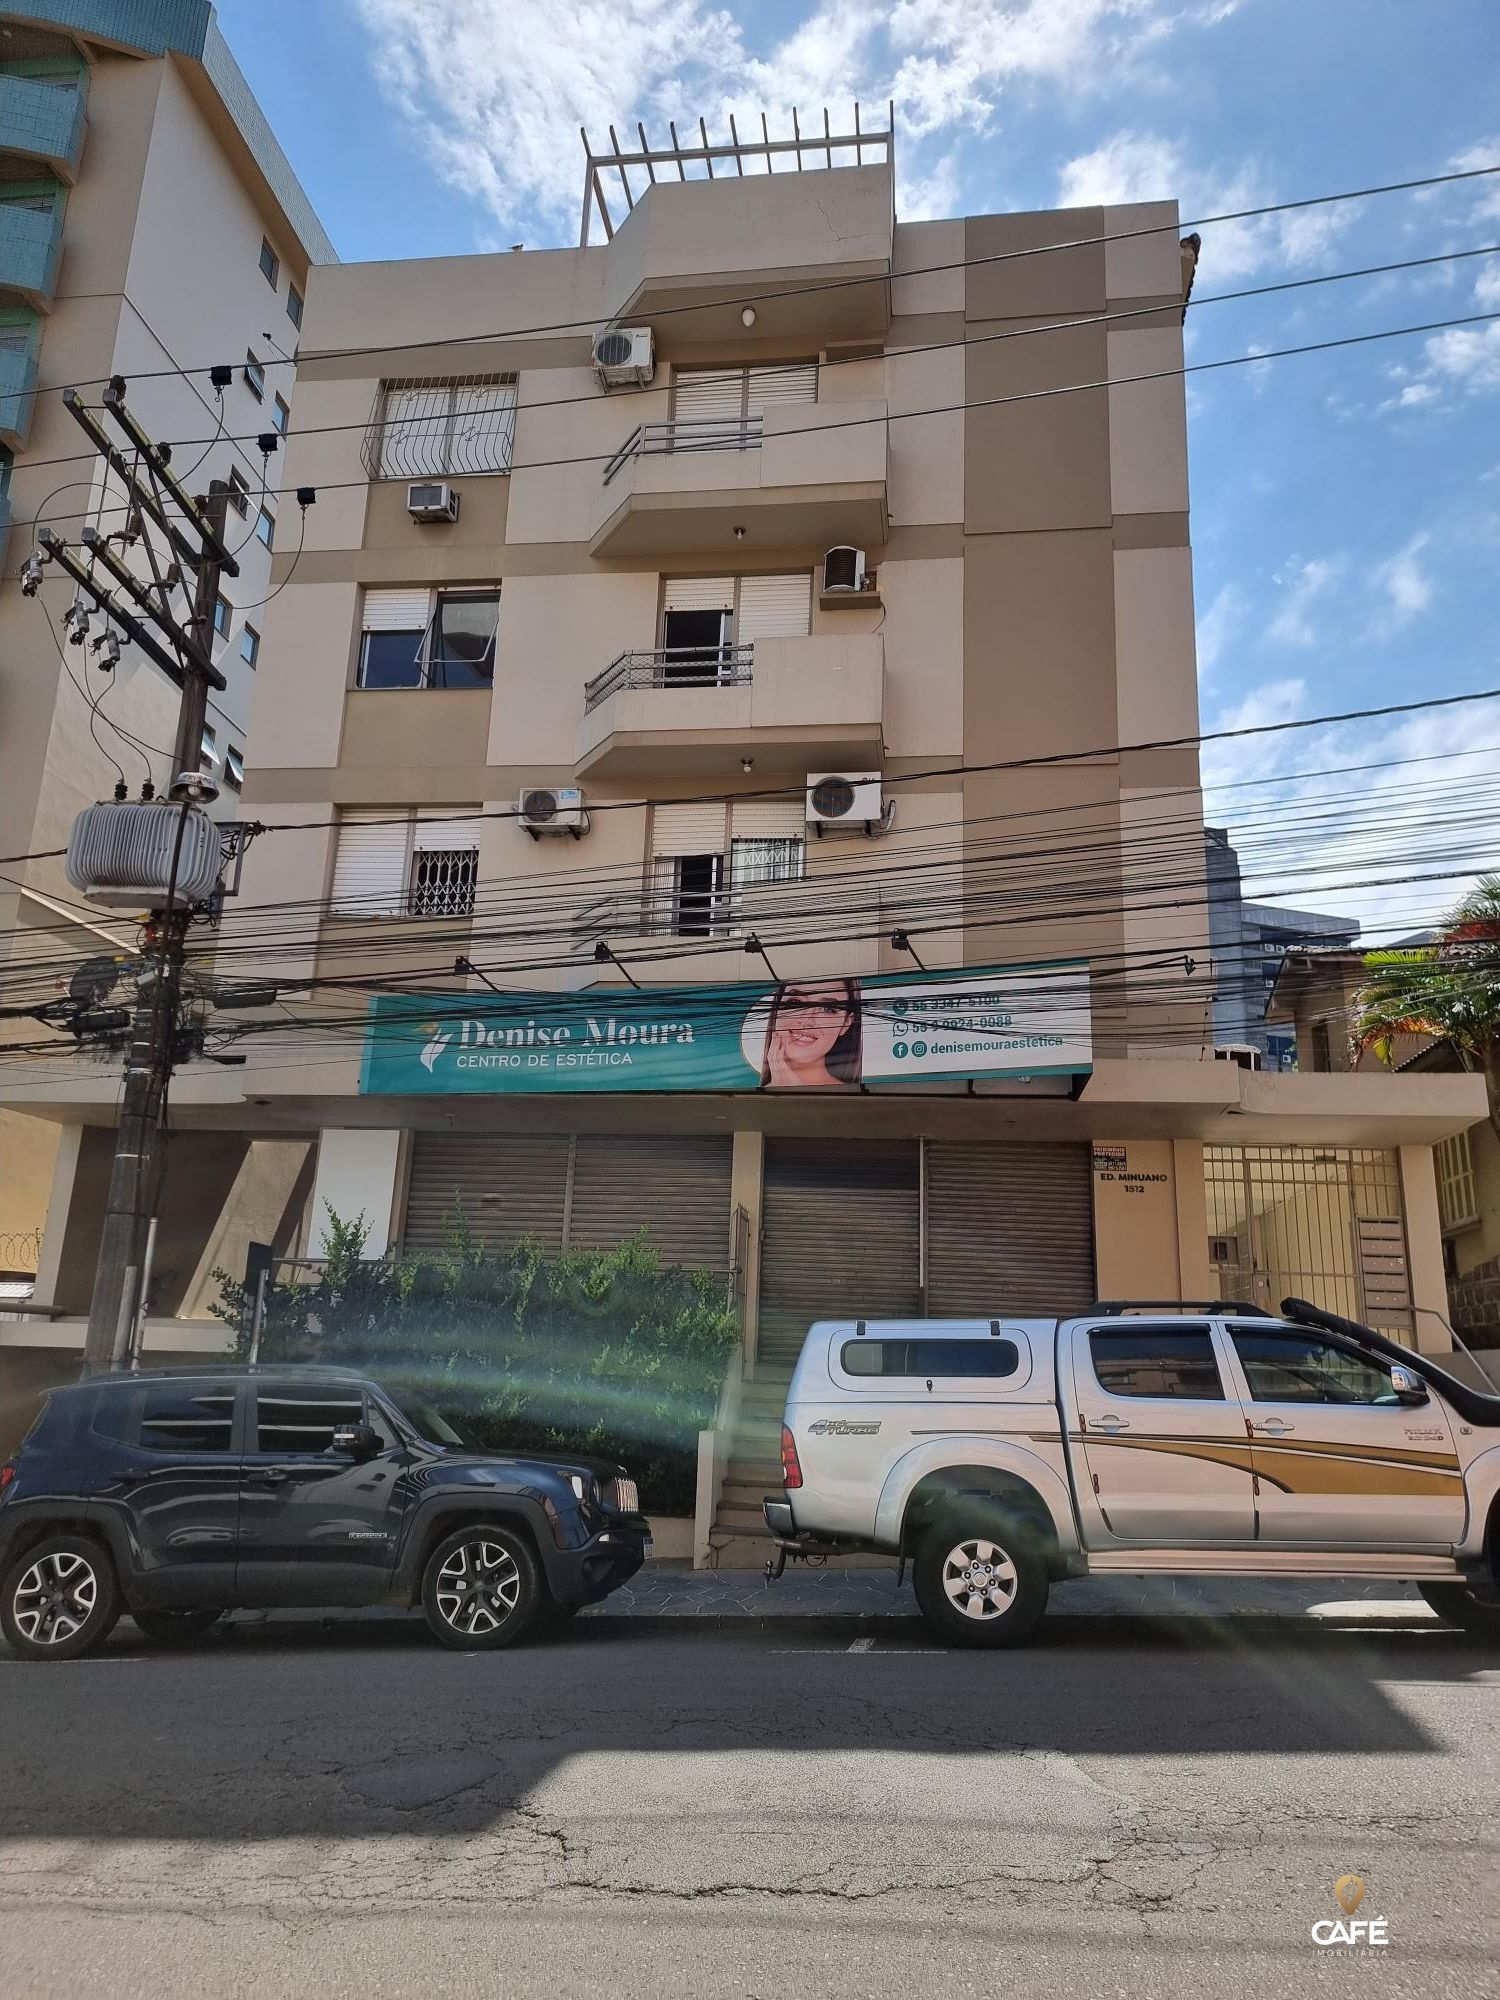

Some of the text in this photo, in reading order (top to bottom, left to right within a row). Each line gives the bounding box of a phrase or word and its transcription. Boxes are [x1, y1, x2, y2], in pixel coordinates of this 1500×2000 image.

[459, 1018, 695, 1048] Denise Moura
[931, 1036, 1063, 1054] denisemouraestetica
[456, 1049, 632, 1068] CENTRO DE ESTÉTICA
[1100, 1173, 1168, 1182] ED. MINUANO
[827, 1426, 880, 1435] TURBO
